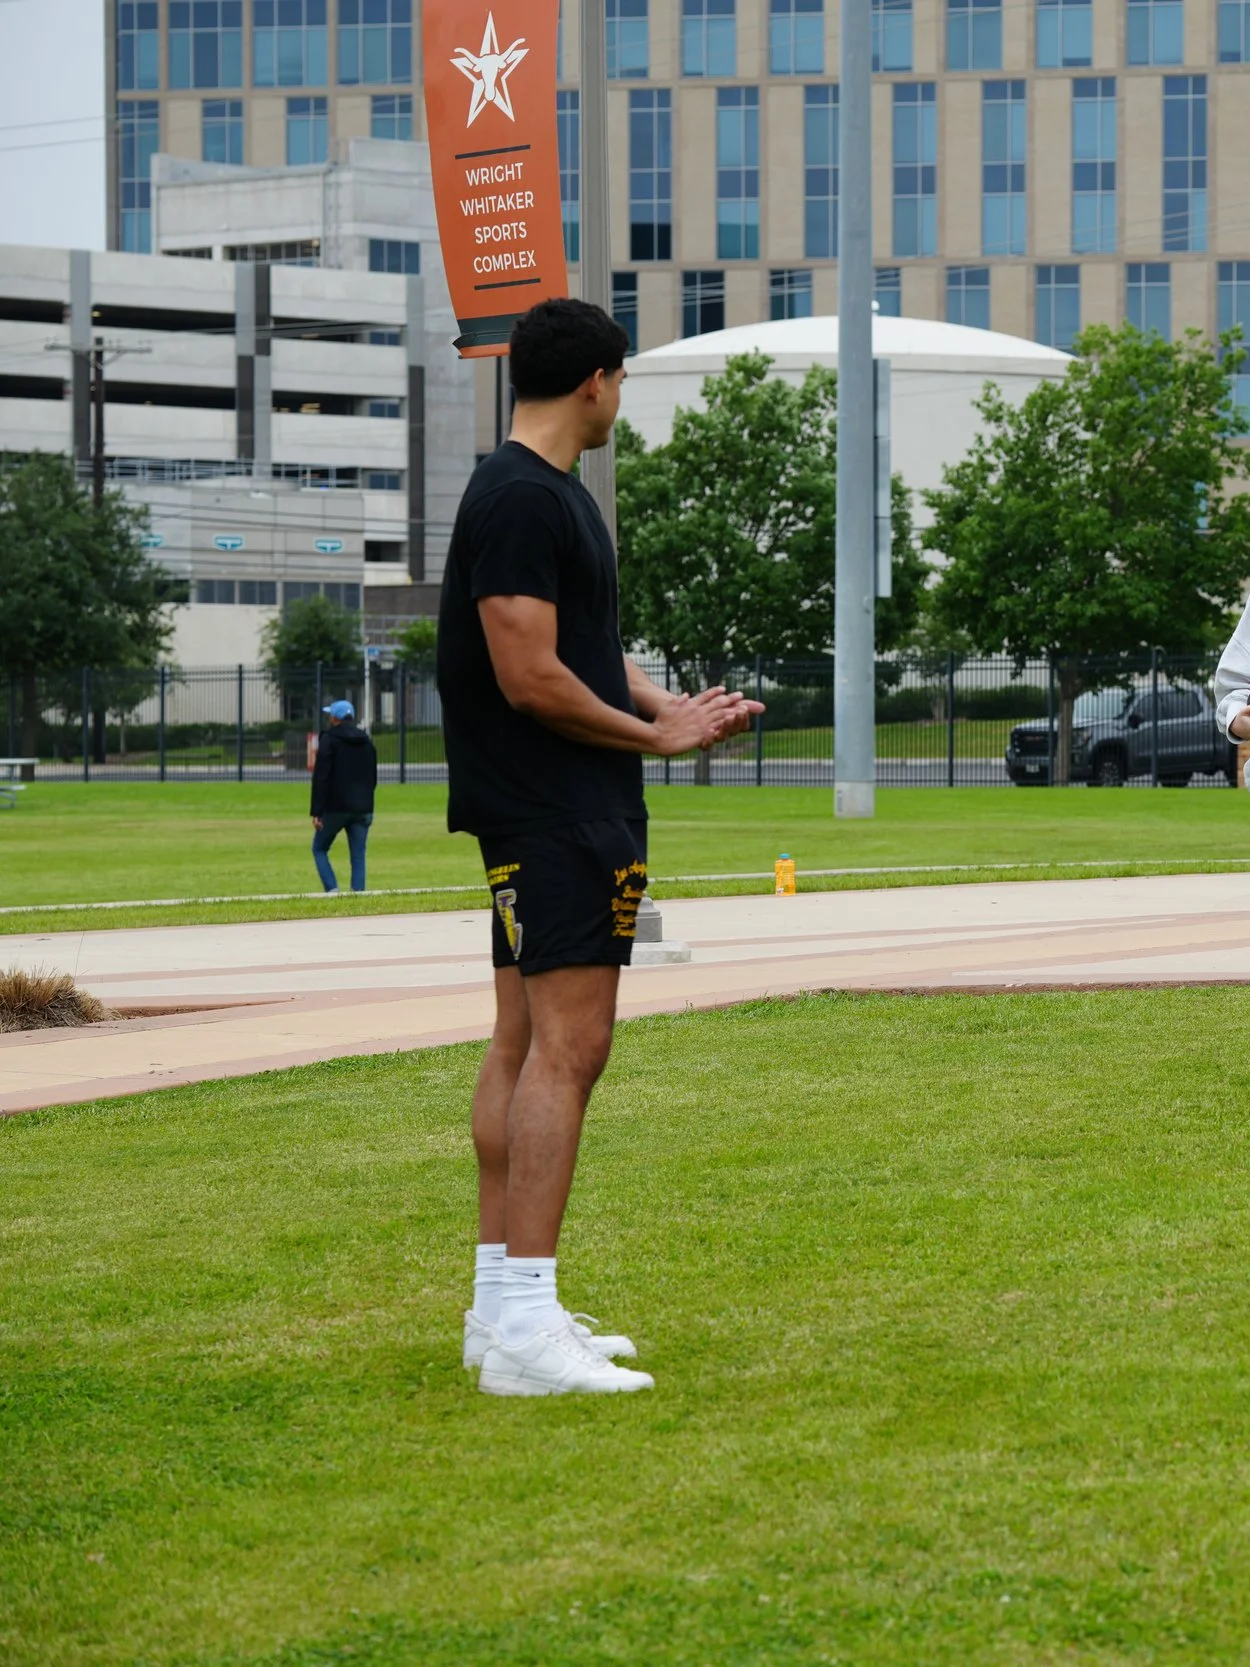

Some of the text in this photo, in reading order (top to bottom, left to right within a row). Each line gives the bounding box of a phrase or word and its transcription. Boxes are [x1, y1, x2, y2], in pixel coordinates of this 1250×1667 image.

[465, 162, 524, 187] WRIGHT
[459, 190, 535, 217] WHITAKER
[474, 221, 528, 245] SPORTS
[473, 250, 537, 274] COMPLEX
